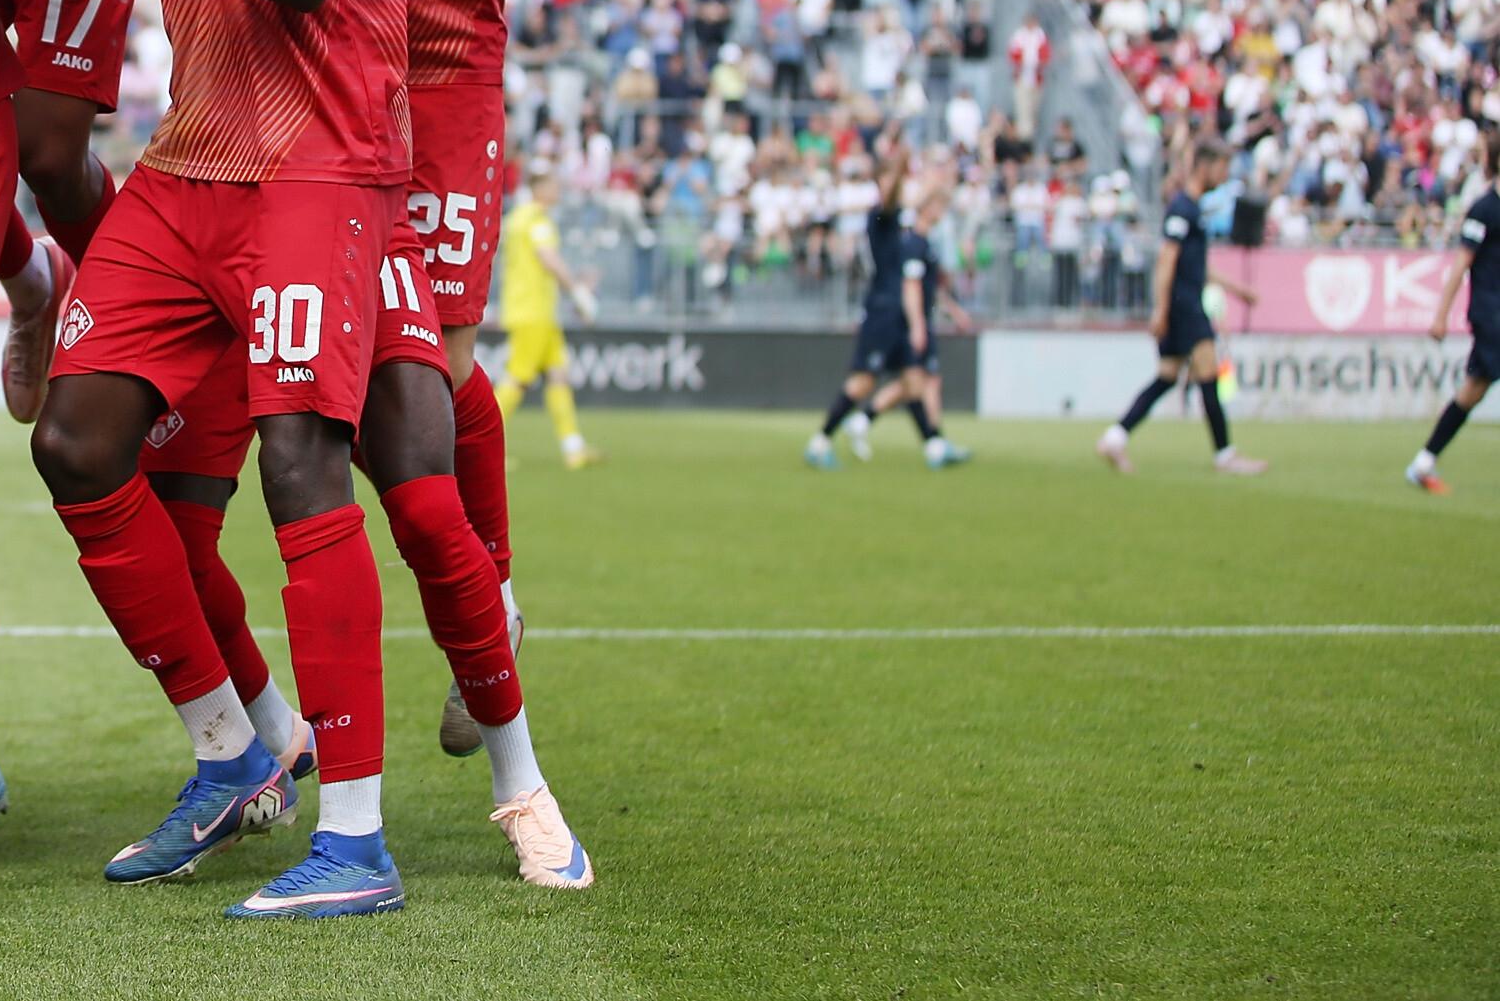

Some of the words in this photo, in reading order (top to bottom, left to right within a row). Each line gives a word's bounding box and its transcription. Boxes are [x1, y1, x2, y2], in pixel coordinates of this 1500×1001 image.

[51, 51, 93, 72] JAKO
[407, 192, 477, 266] 25
[379, 255, 421, 313] 11
[248, 283, 324, 364] 30
[400, 323, 439, 347] JAKO
[276, 367, 315, 384] JAKO
[566, 334, 705, 391] werk
[1237, 343, 1466, 394] unschw
[312, 714, 351, 731] AKO
